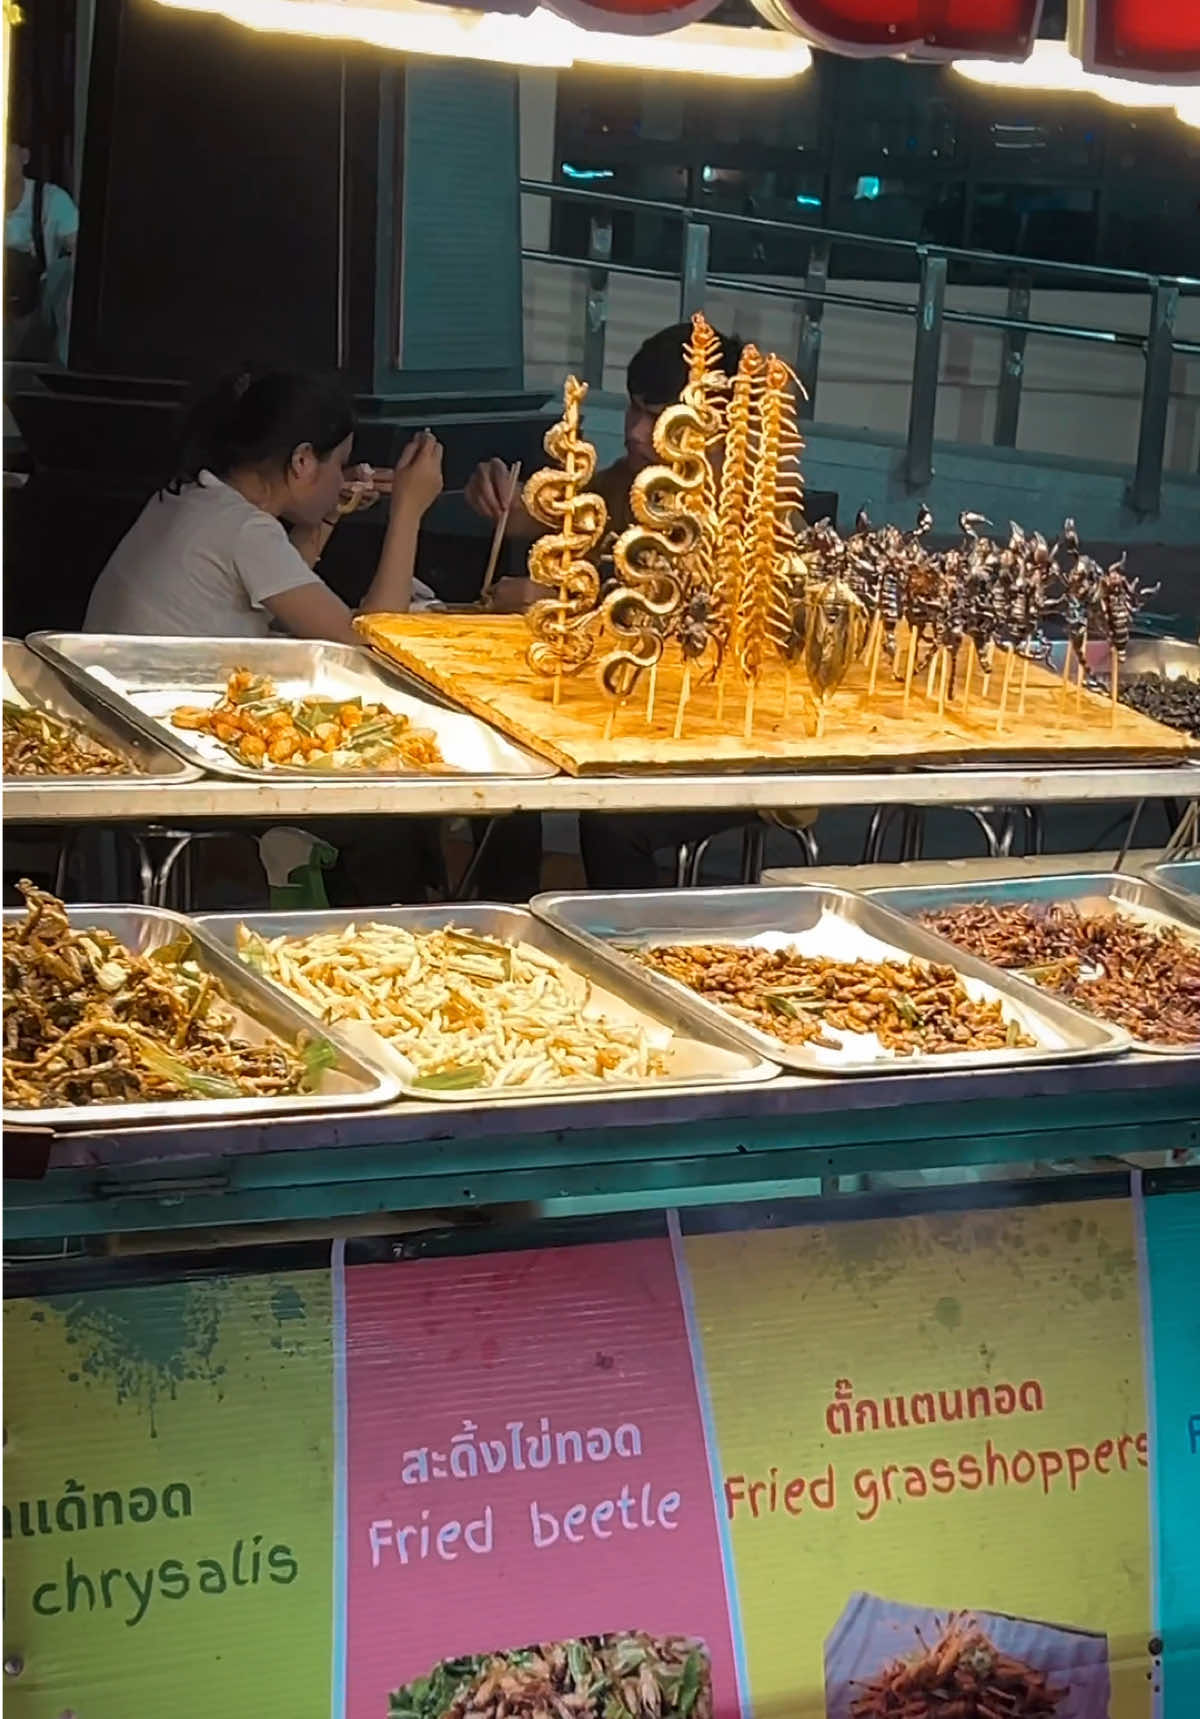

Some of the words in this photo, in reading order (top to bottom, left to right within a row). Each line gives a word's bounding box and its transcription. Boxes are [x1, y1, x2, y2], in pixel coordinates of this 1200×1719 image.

[825, 1378, 1045, 1435] ตั๊กแตนทอด
[369, 1505, 494, 1568] Fried
[529, 1483, 682, 1549] beetle
[724, 1464, 836, 1520] Fried
[32, 1535, 298, 1627] chrysalis
